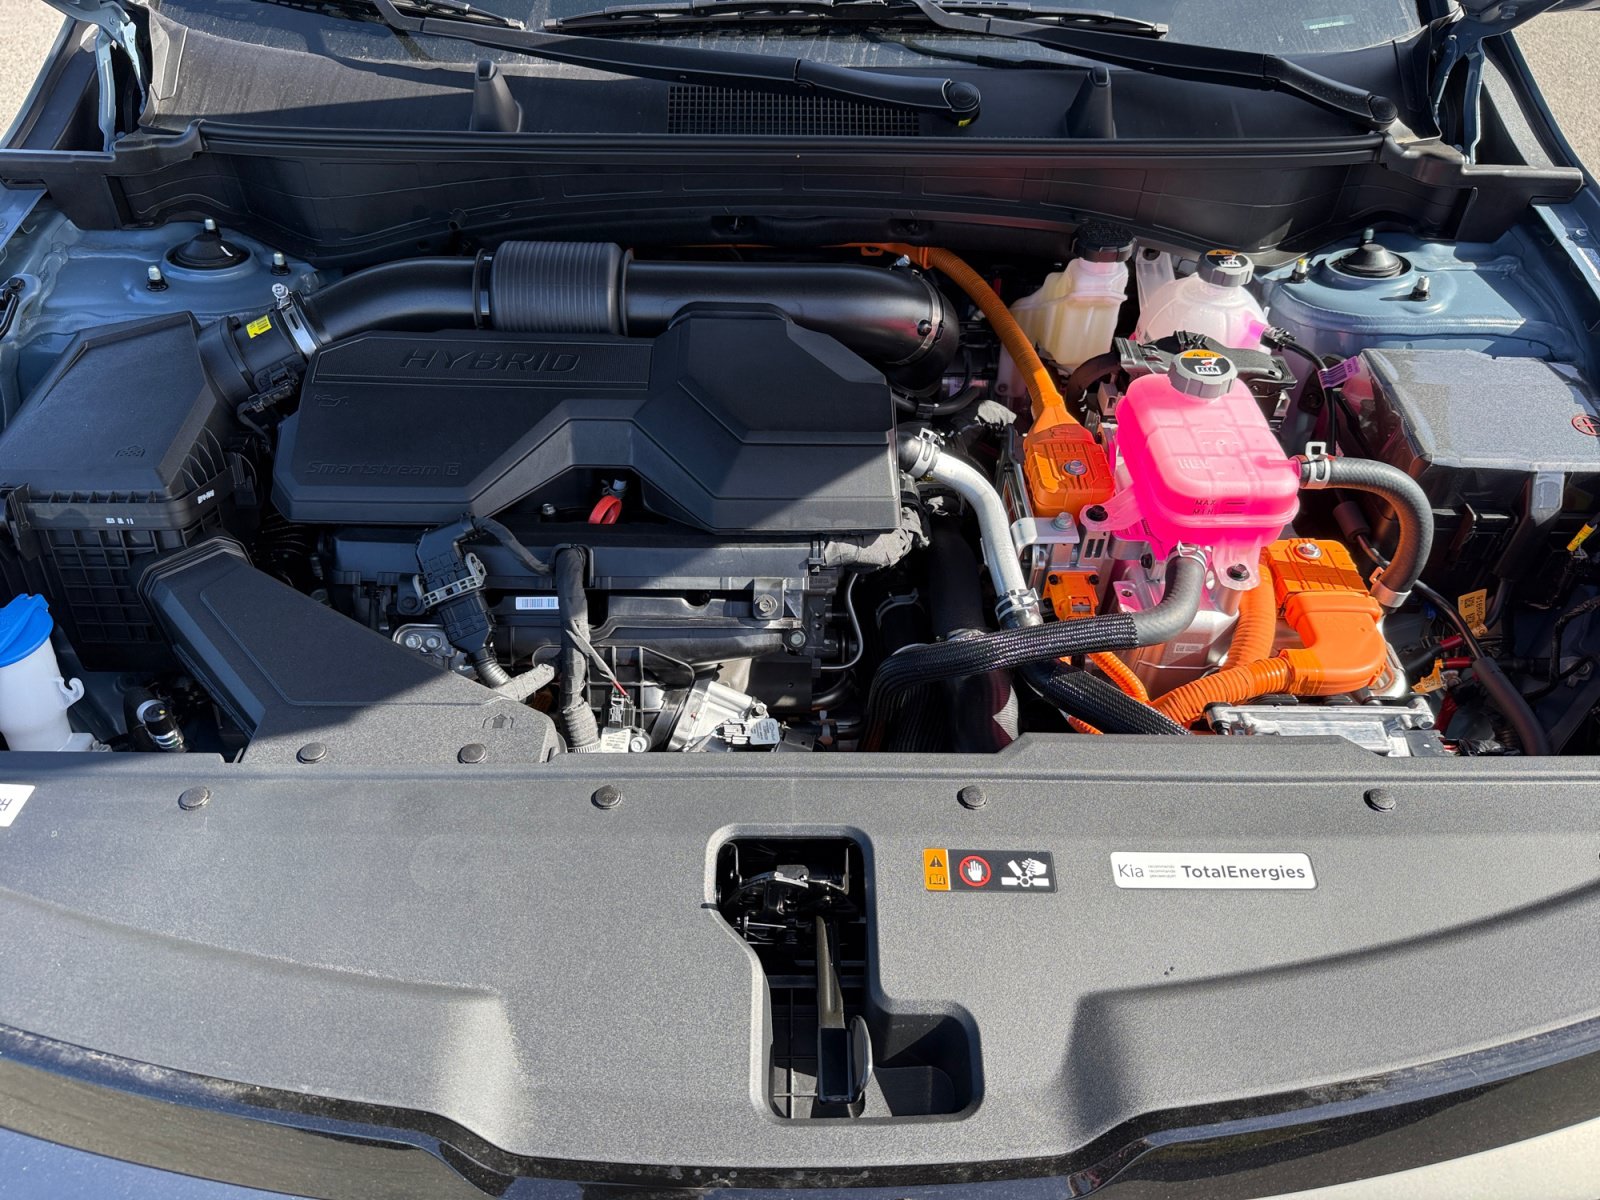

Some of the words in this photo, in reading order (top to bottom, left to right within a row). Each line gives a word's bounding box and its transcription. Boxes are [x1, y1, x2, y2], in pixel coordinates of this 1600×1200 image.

[400, 349, 581, 373] HYBRID
[305, 460, 440, 476] Smartstream
[1117, 863, 1145, 878] Kia
[1181, 864, 1306, 881] TotalEnergies
